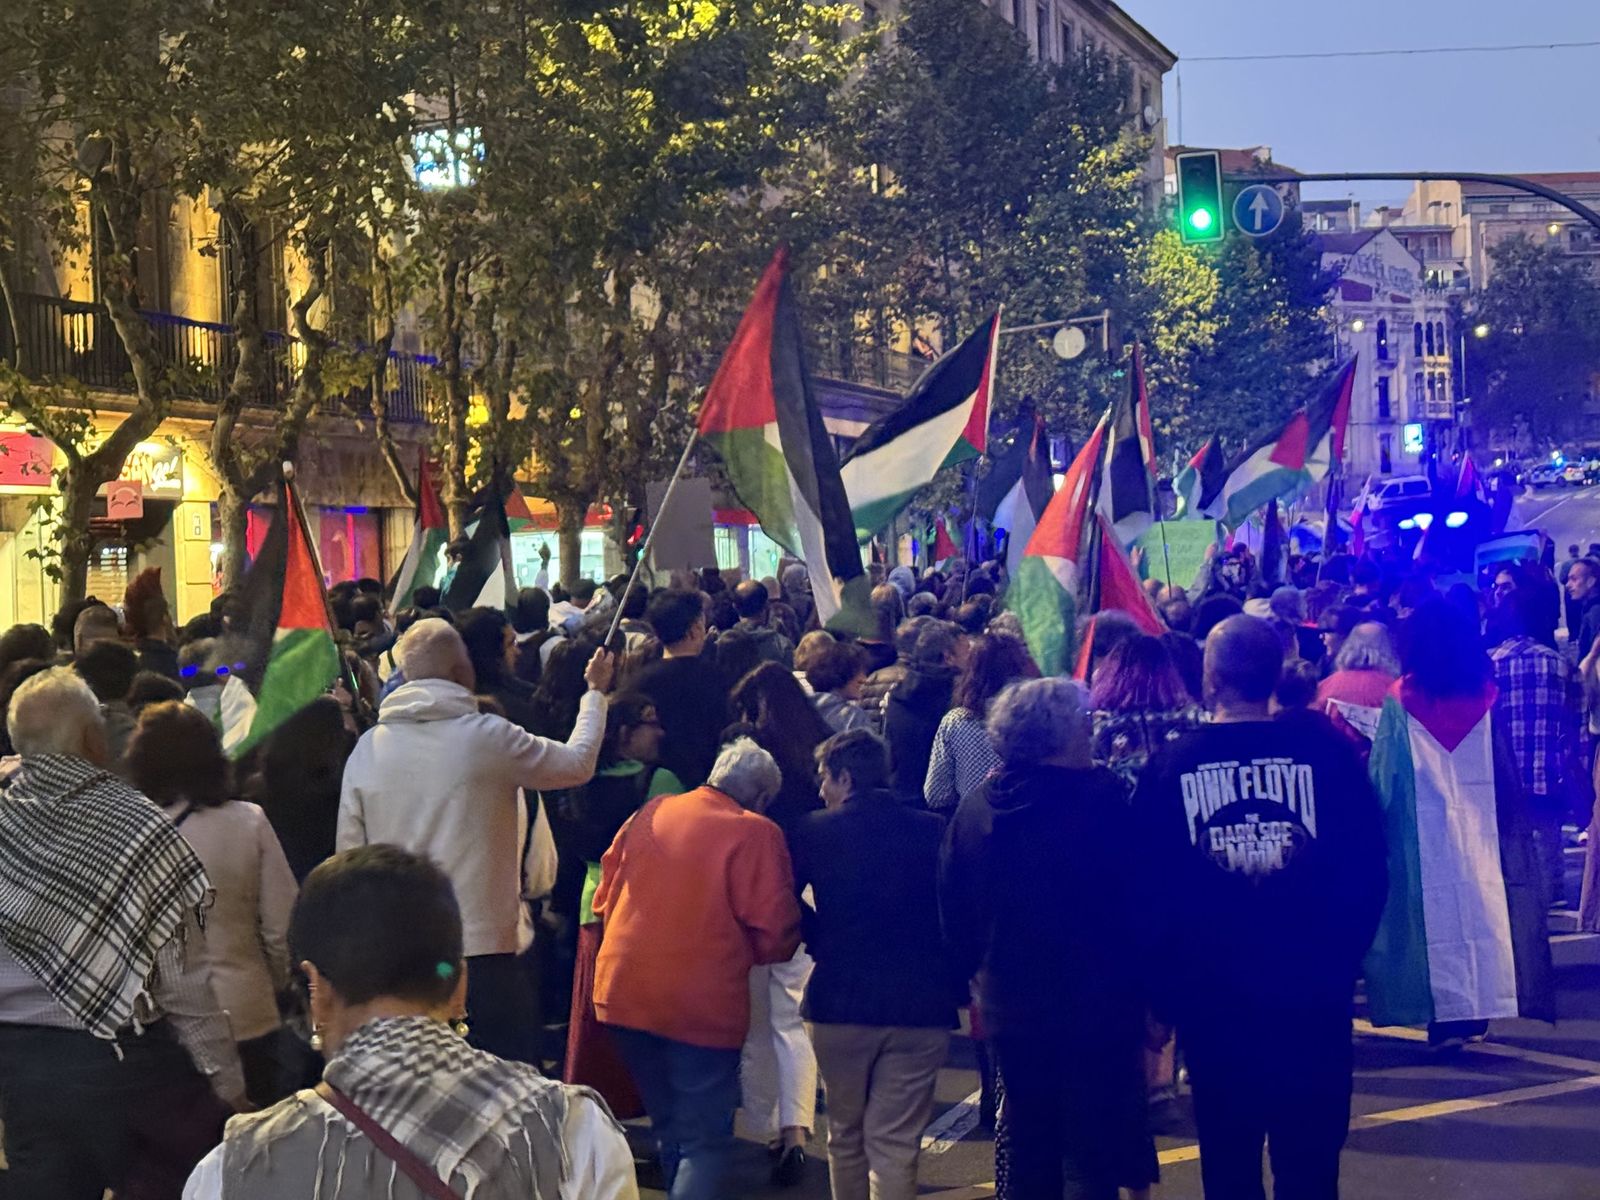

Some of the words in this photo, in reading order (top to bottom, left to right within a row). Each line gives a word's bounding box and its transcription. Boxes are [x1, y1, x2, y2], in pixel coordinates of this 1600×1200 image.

[1180, 761, 1239, 846] PINK
[1239, 758, 1317, 839] FLOYD
[1209, 824, 1257, 851] DARK
